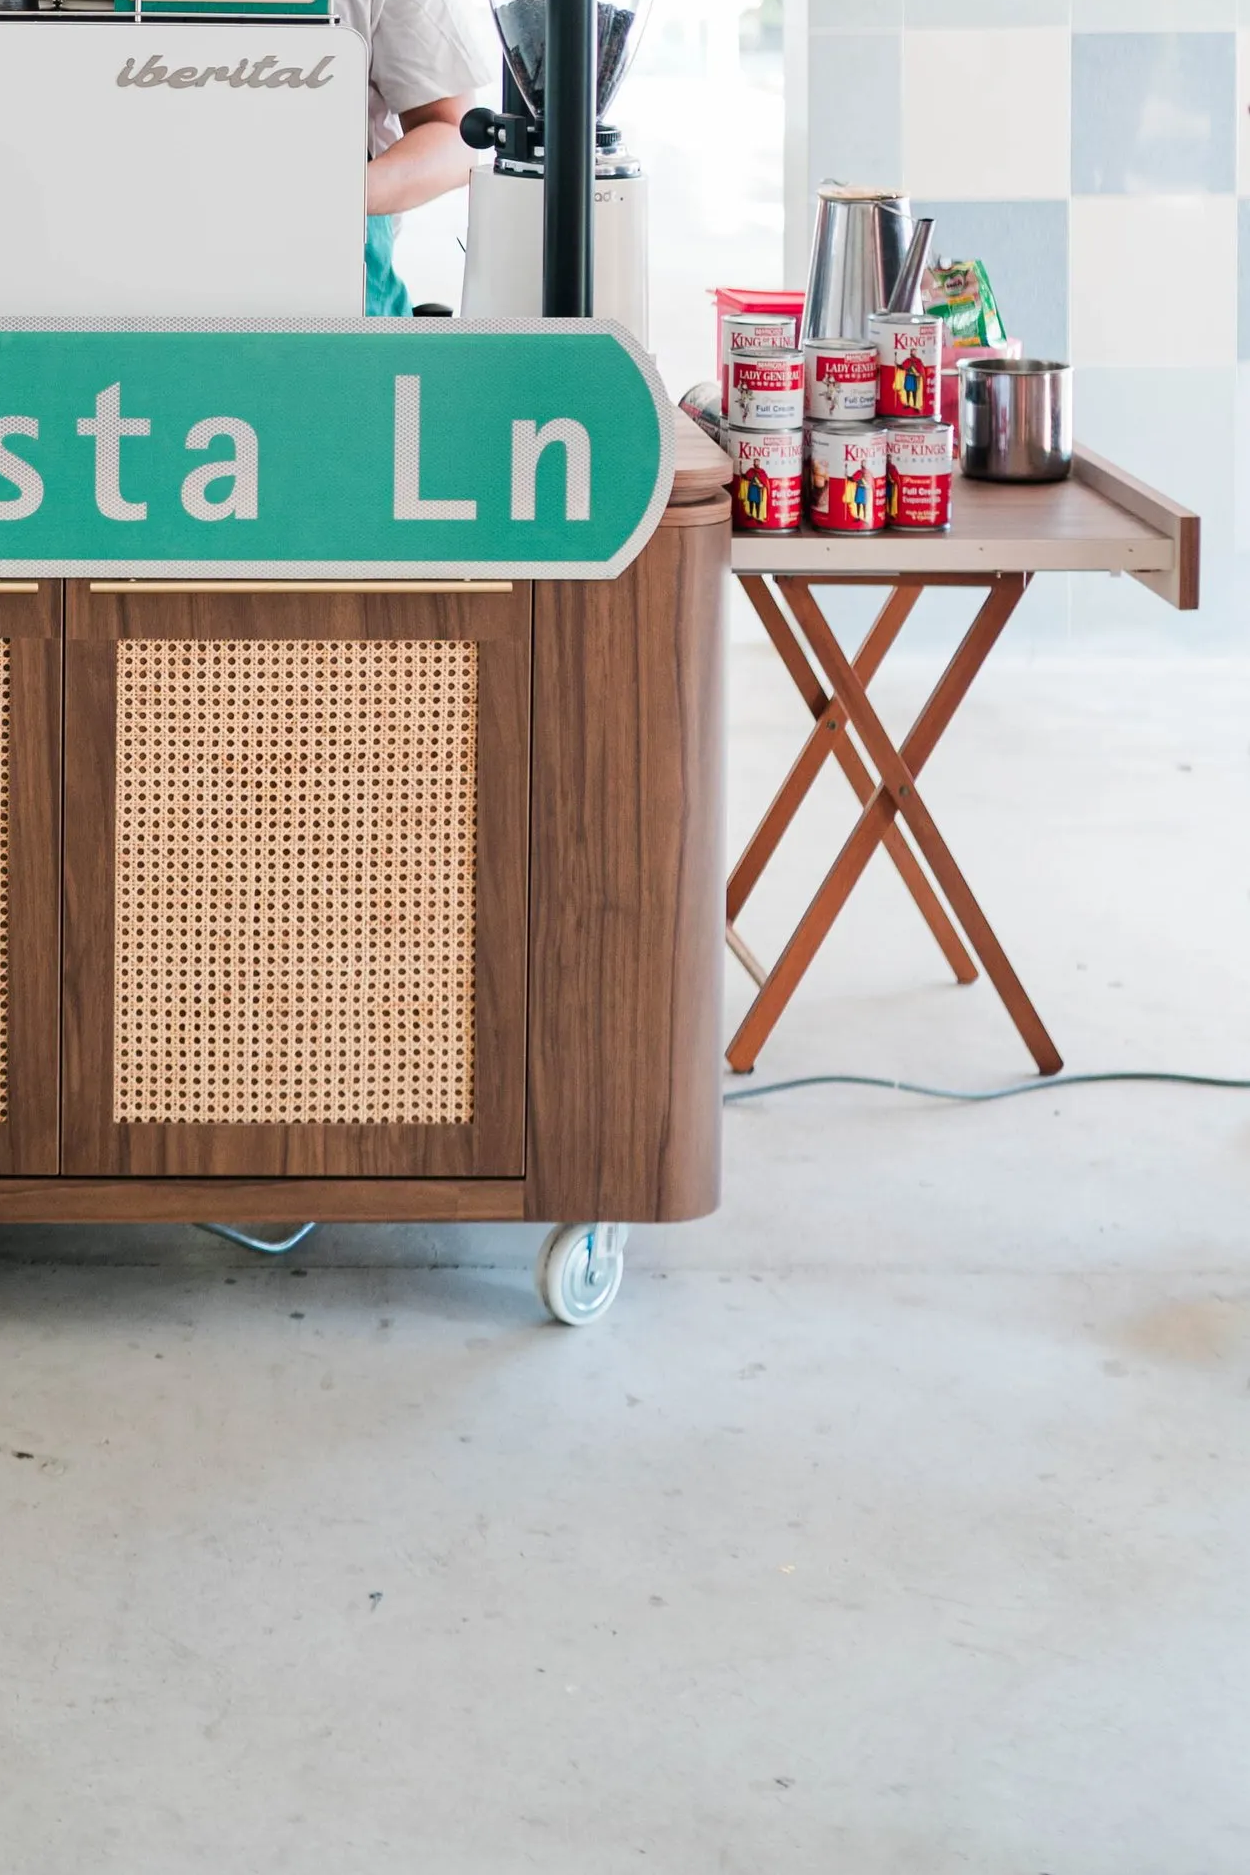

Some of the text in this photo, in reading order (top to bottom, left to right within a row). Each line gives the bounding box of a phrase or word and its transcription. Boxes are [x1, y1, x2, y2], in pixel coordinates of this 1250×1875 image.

[116, 55, 336, 89] iberital
[731, 332, 762, 350] KING
[894, 333, 926, 350] KING
[740, 370, 761, 380] LADY
[825, 362, 848, 373] LADY
[392, 374, 592, 521] Ln
[739, 441, 770, 460] KING
[844, 444, 875, 462] KING
[911, 443, 946, 456] KINGS
